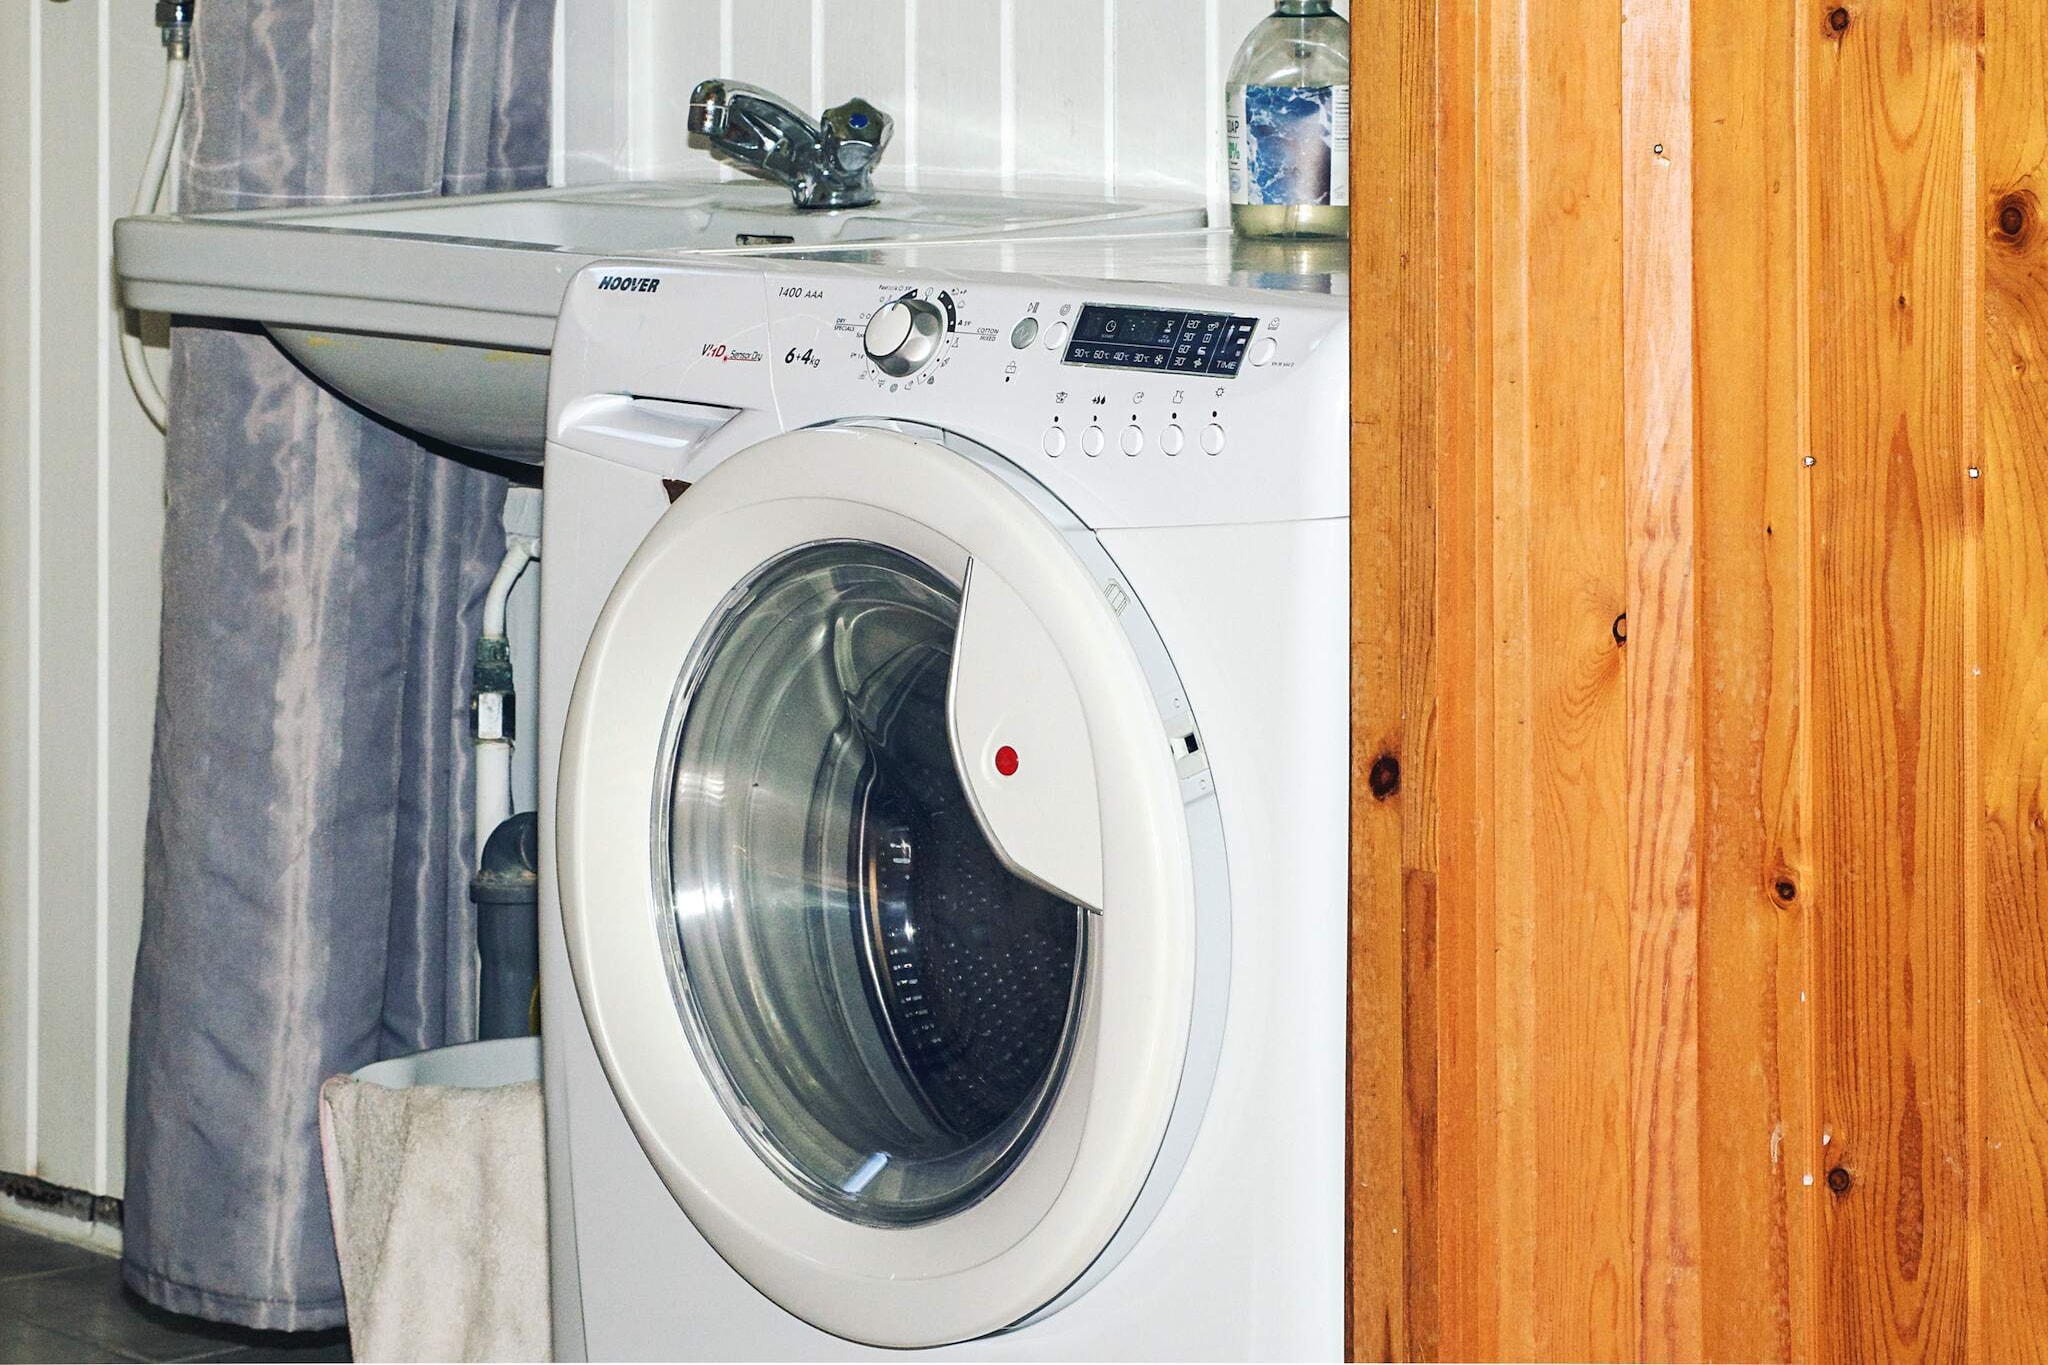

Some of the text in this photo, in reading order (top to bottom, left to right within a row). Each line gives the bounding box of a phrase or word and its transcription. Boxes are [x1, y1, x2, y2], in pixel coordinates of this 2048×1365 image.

[598, 276, 660, 293] HOOVER
[778, 286, 823, 299] 1400 AAA
[1216, 360, 1238, 370] TIME
